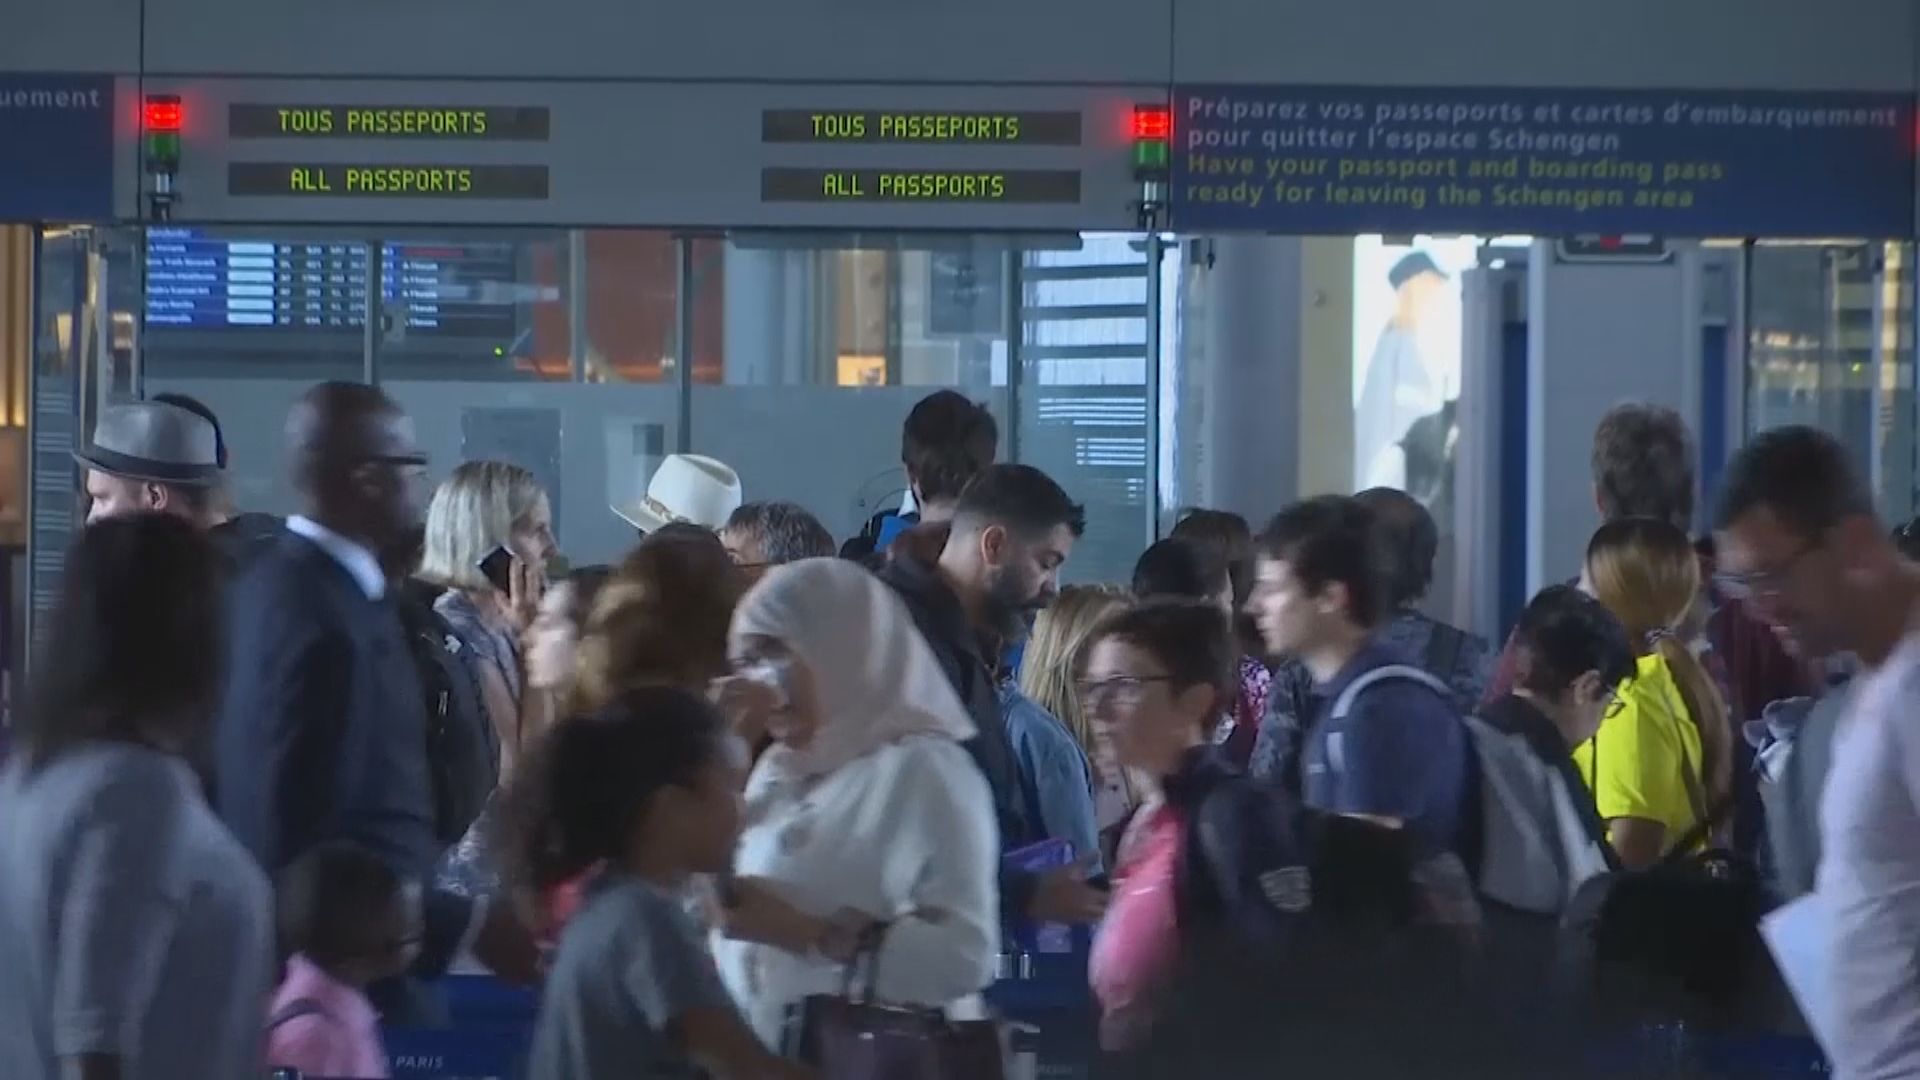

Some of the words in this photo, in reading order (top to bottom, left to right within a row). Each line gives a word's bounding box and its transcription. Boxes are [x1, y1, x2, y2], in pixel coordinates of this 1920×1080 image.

[0, 88, 101, 108] uement
[278, 109, 333, 132] TOUS
[347, 109, 487, 133] PASSEPORTS
[1188, 97, 1308, 122] Préparez
[1319, 103, 1365, 119] vos
[1376, 103, 1522, 125] passeports
[1534, 105, 1560, 121] et
[1571, 105, 1653, 124] cartes
[1663, 102, 1897, 129] d'embarquement
[811, 115, 866, 138] TOUS
[879, 115, 1019, 139] PASSEPORTS
[1188, 128, 1250, 148] pour
[1262, 126, 1357, 150] quitter
[1368, 126, 1478, 153] l'espace
[1487, 128, 1619, 155] Schengen
[290, 168, 331, 191] ALL
[346, 169, 471, 192] PASSPORTS
[1188, 155, 1254, 175] Have
[1266, 159, 1328, 178] your
[1339, 158, 1457, 179] passport
[1468, 157, 1518, 177] and
[1529, 157, 1653, 183] boarding
[1663, 161, 1723, 183] pass
[823, 174, 864, 196] ALL
[879, 175, 1004, 197] PASSPORTS
[1187, 182, 1264, 207] ready
[1275, 182, 1314, 202] for
[1326, 183, 1425, 208] leaving
[1438, 184, 1483, 204] the
[1494, 184, 1623, 211] Schengen
[1634, 189, 1694, 208] area
[395, 1055, 444, 1069] PARIS
